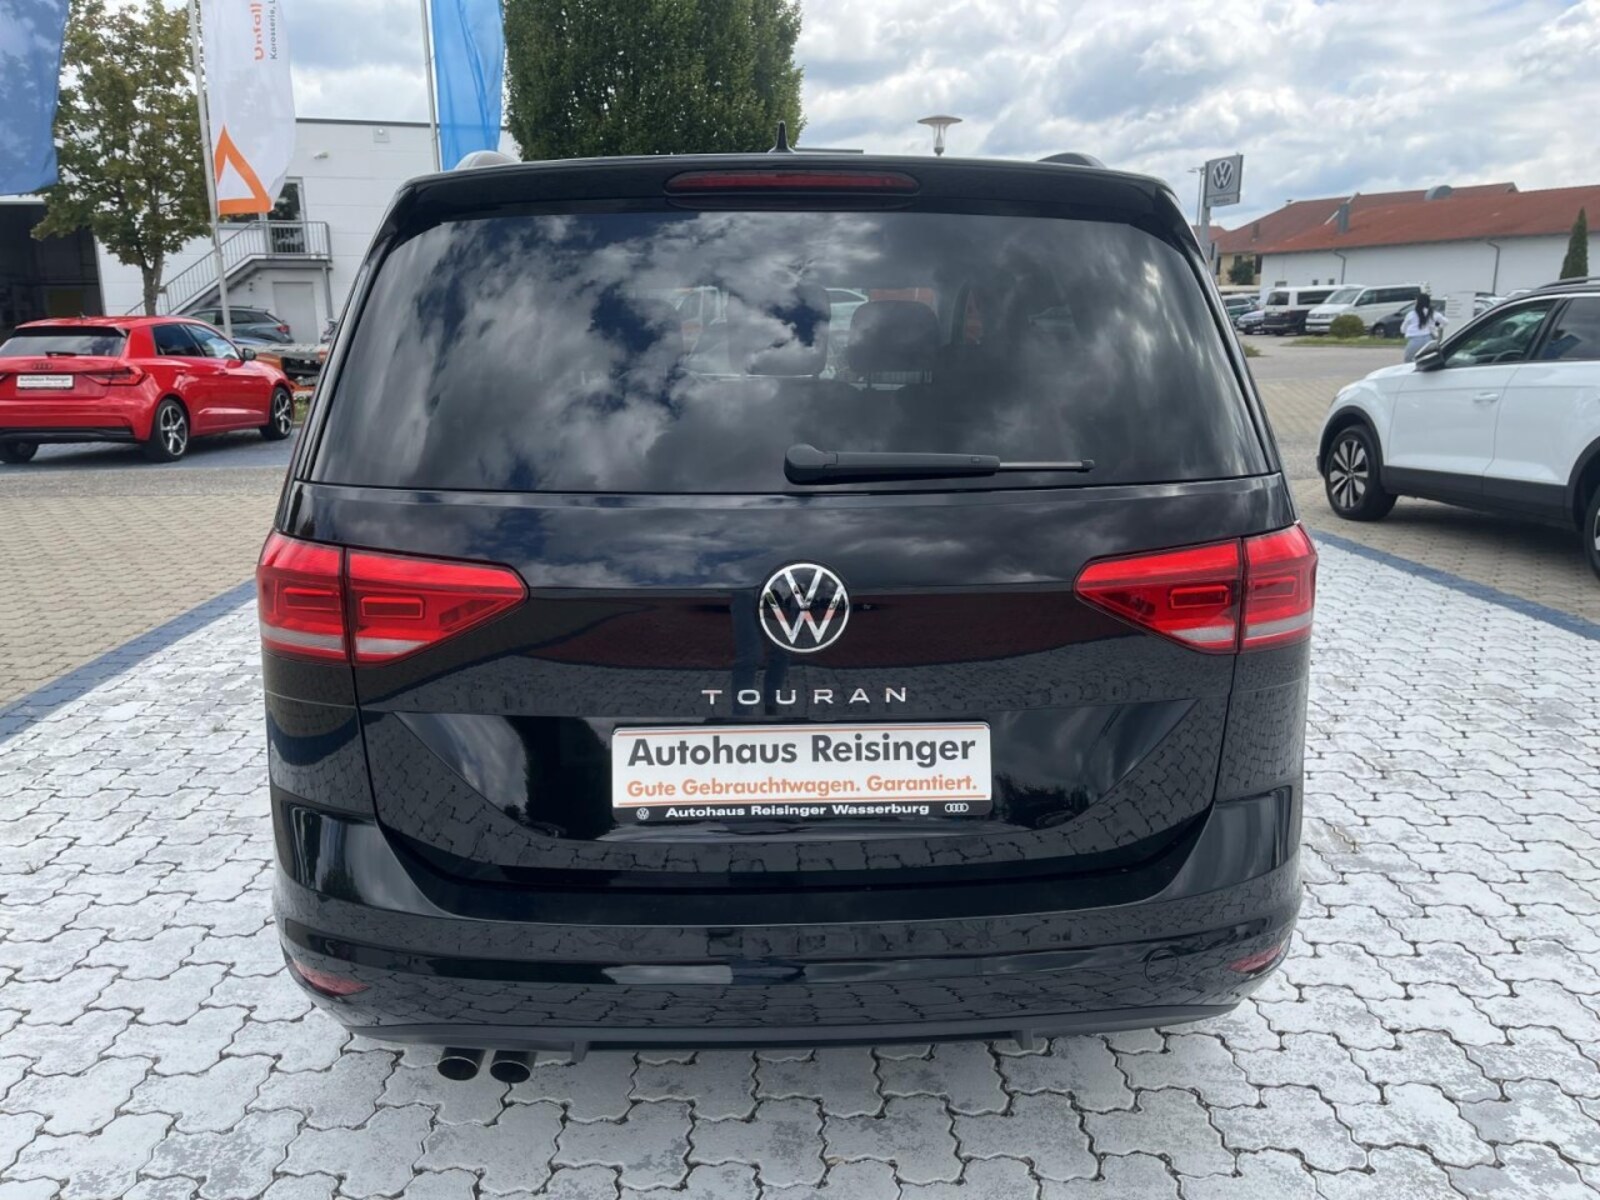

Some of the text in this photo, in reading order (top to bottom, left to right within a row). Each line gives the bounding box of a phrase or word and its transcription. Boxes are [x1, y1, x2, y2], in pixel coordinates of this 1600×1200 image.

[250, 3, 264, 60] Unfall
[701, 687, 906, 705] TOURAN
[627, 732, 976, 768] Autohaus Reisinger
[627, 774, 977, 797] Gute Gebrauchtwagen. Garantiert.
[665, 804, 930, 817] Autohaus Reisinger Wasserburg
